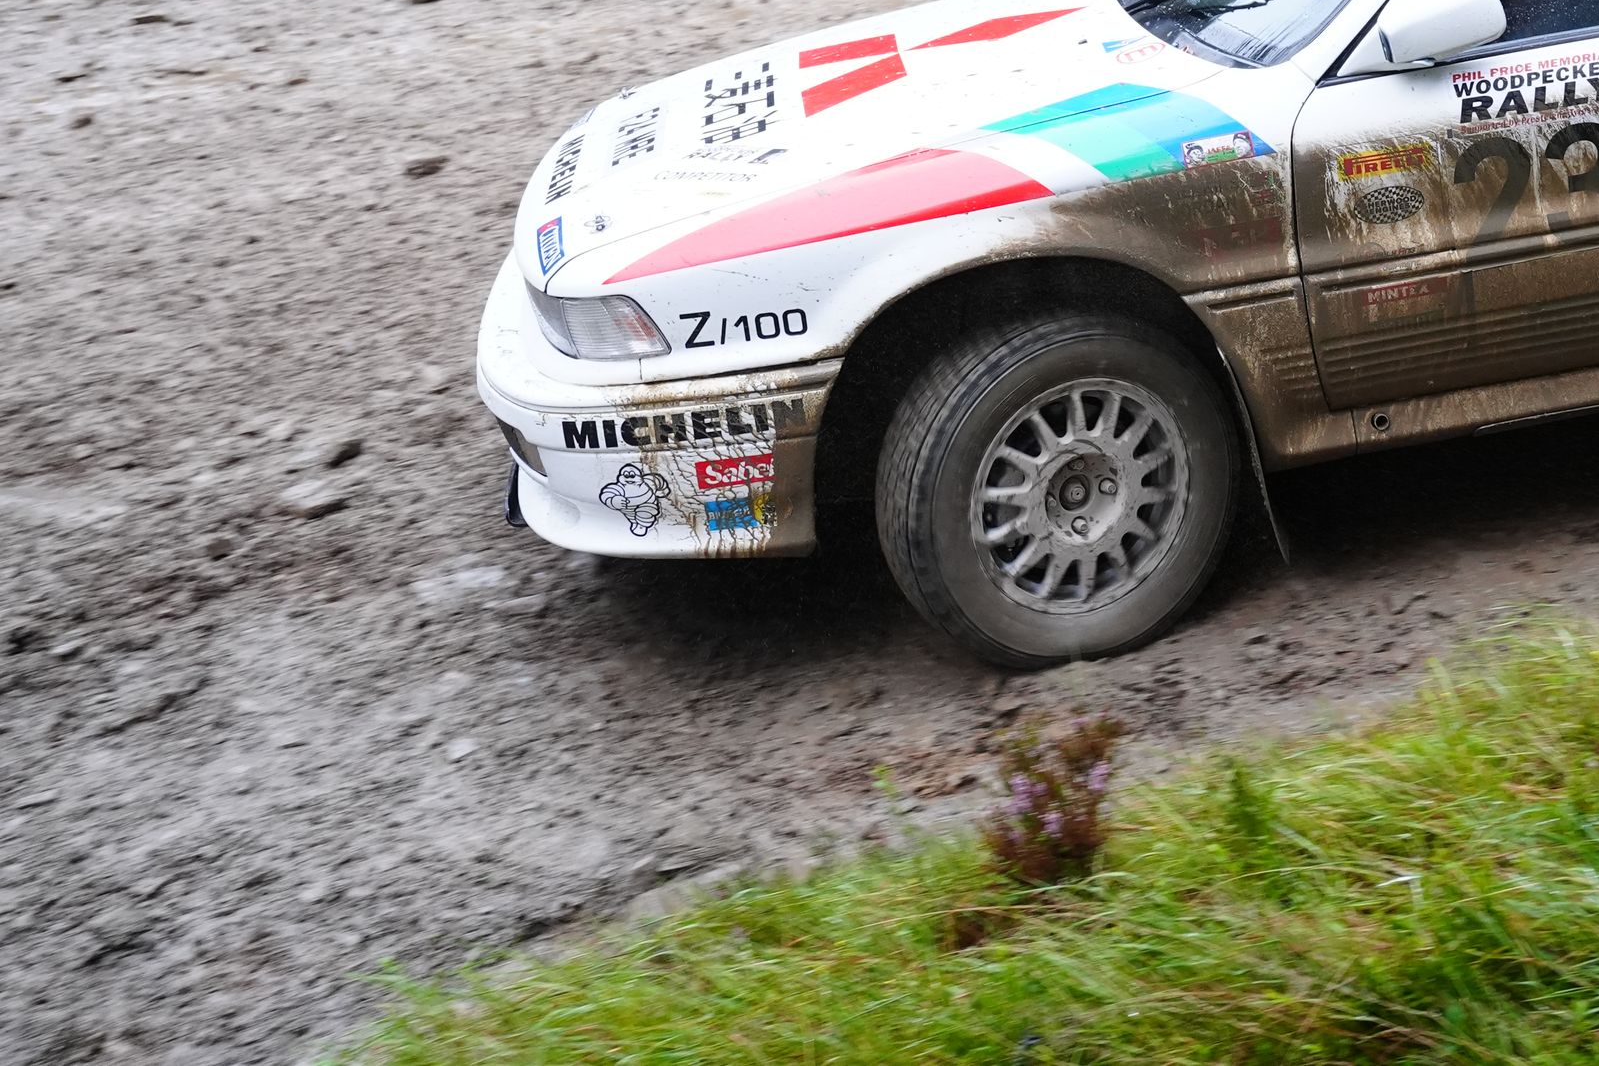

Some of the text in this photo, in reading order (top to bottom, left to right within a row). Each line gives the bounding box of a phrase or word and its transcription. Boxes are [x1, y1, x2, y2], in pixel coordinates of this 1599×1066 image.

[1453, 71, 1485, 84] PHIL
[1490, 62, 1533, 77] PRICE
[544, 133, 586, 206] MICHELIN
[1361, 195, 1417, 210] HERWOOD
[679, 308, 808, 349] Z/100
[562, 398, 807, 449] MICHELIN
